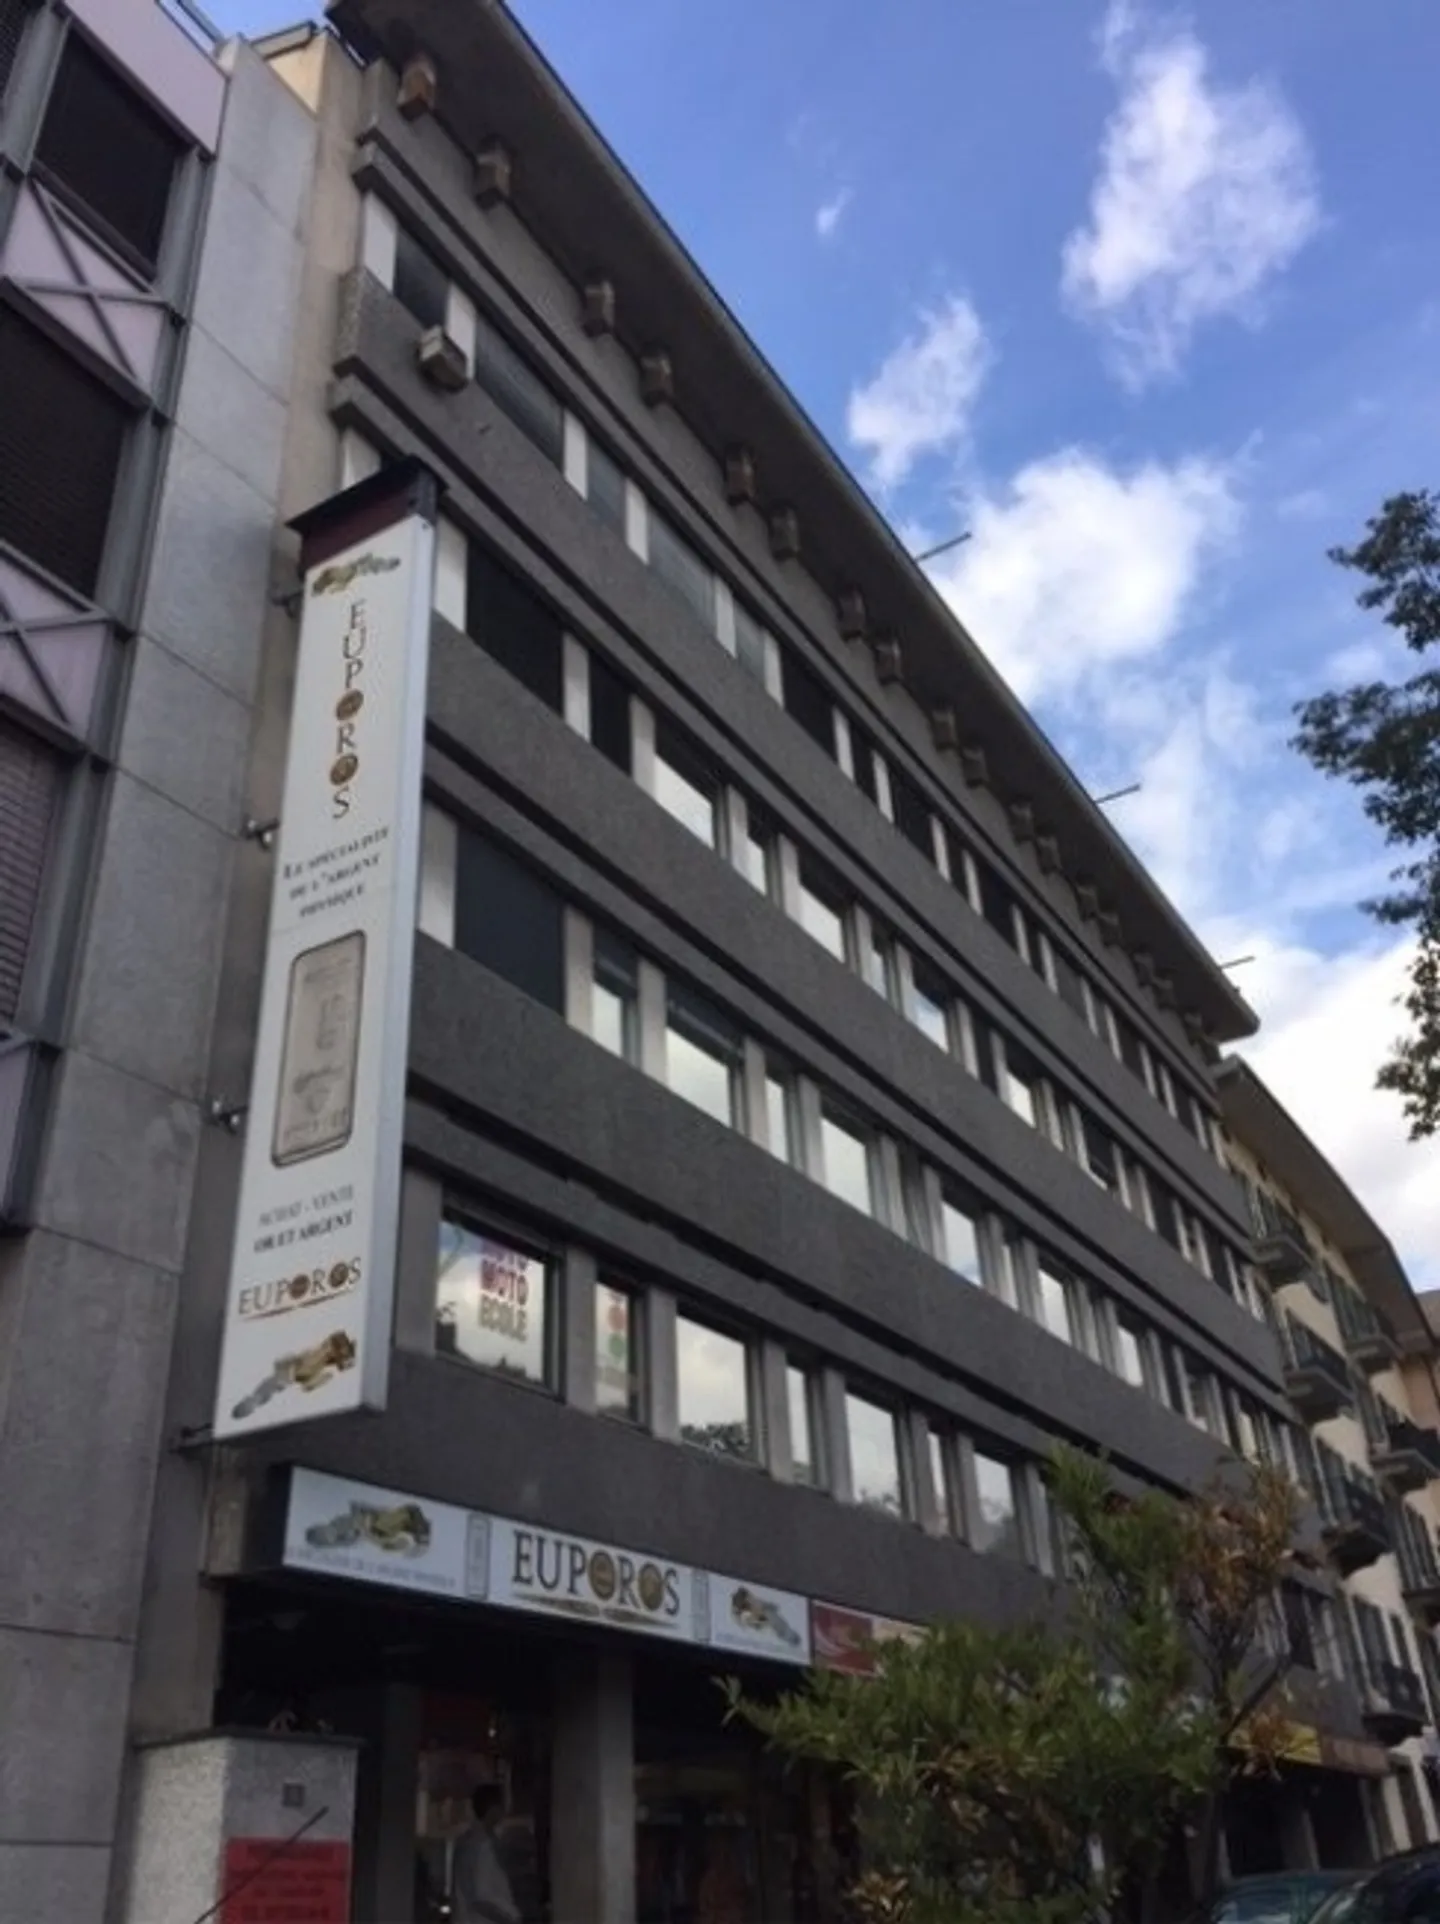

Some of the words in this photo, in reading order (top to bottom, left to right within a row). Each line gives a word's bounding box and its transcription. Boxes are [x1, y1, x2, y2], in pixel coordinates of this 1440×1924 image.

[330, 600, 366, 819] EUPOROS
[298, 1209, 354, 1241] ARGENT
[238, 1256, 362, 1316] EUPOROS
[511, 1528, 681, 1617] EUPOROS
